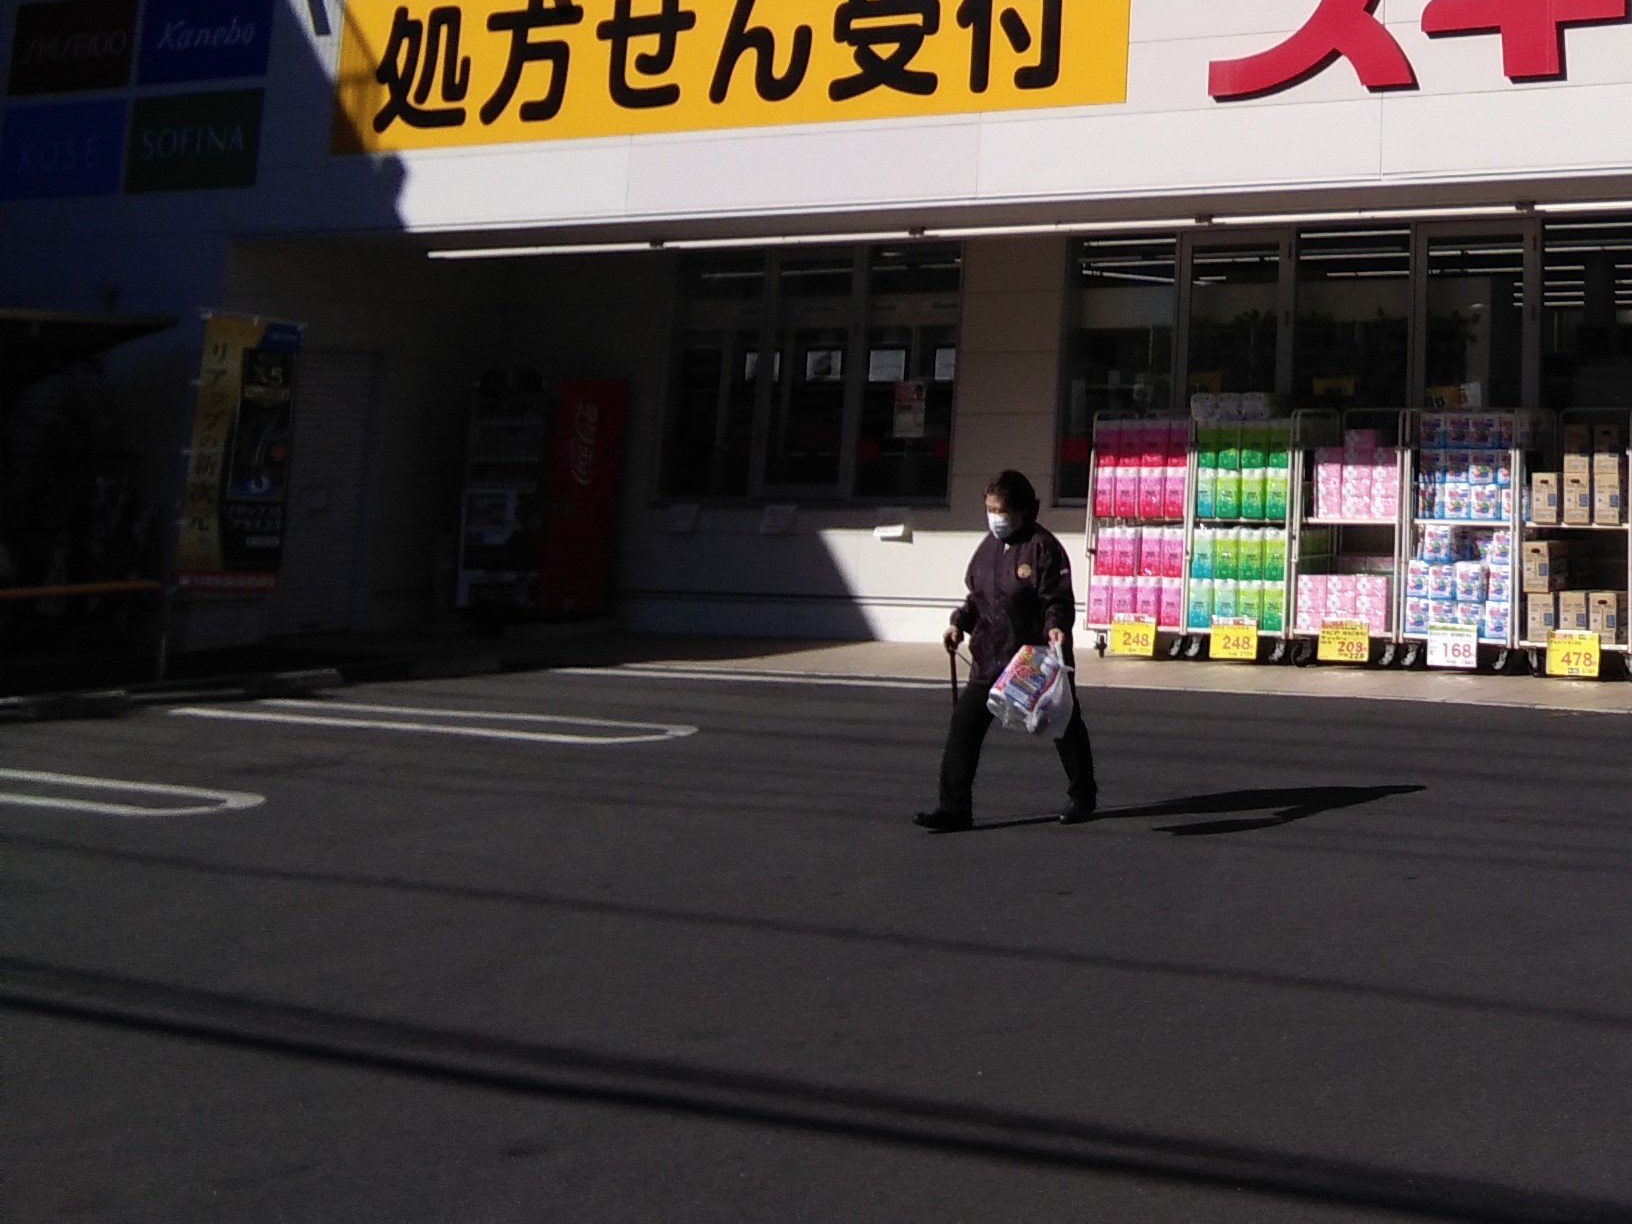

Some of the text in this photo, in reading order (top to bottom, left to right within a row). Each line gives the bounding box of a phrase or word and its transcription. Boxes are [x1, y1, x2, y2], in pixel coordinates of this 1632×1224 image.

[156, 15, 257, 51] Kanebo
[141, 122, 245, 161] SOFINA
[1122, 632, 1149, 647] 248
[1222, 635, 1251, 650] 248
[1442, 643, 1472, 659] 168
[1560, 651, 1593, 667] 478
